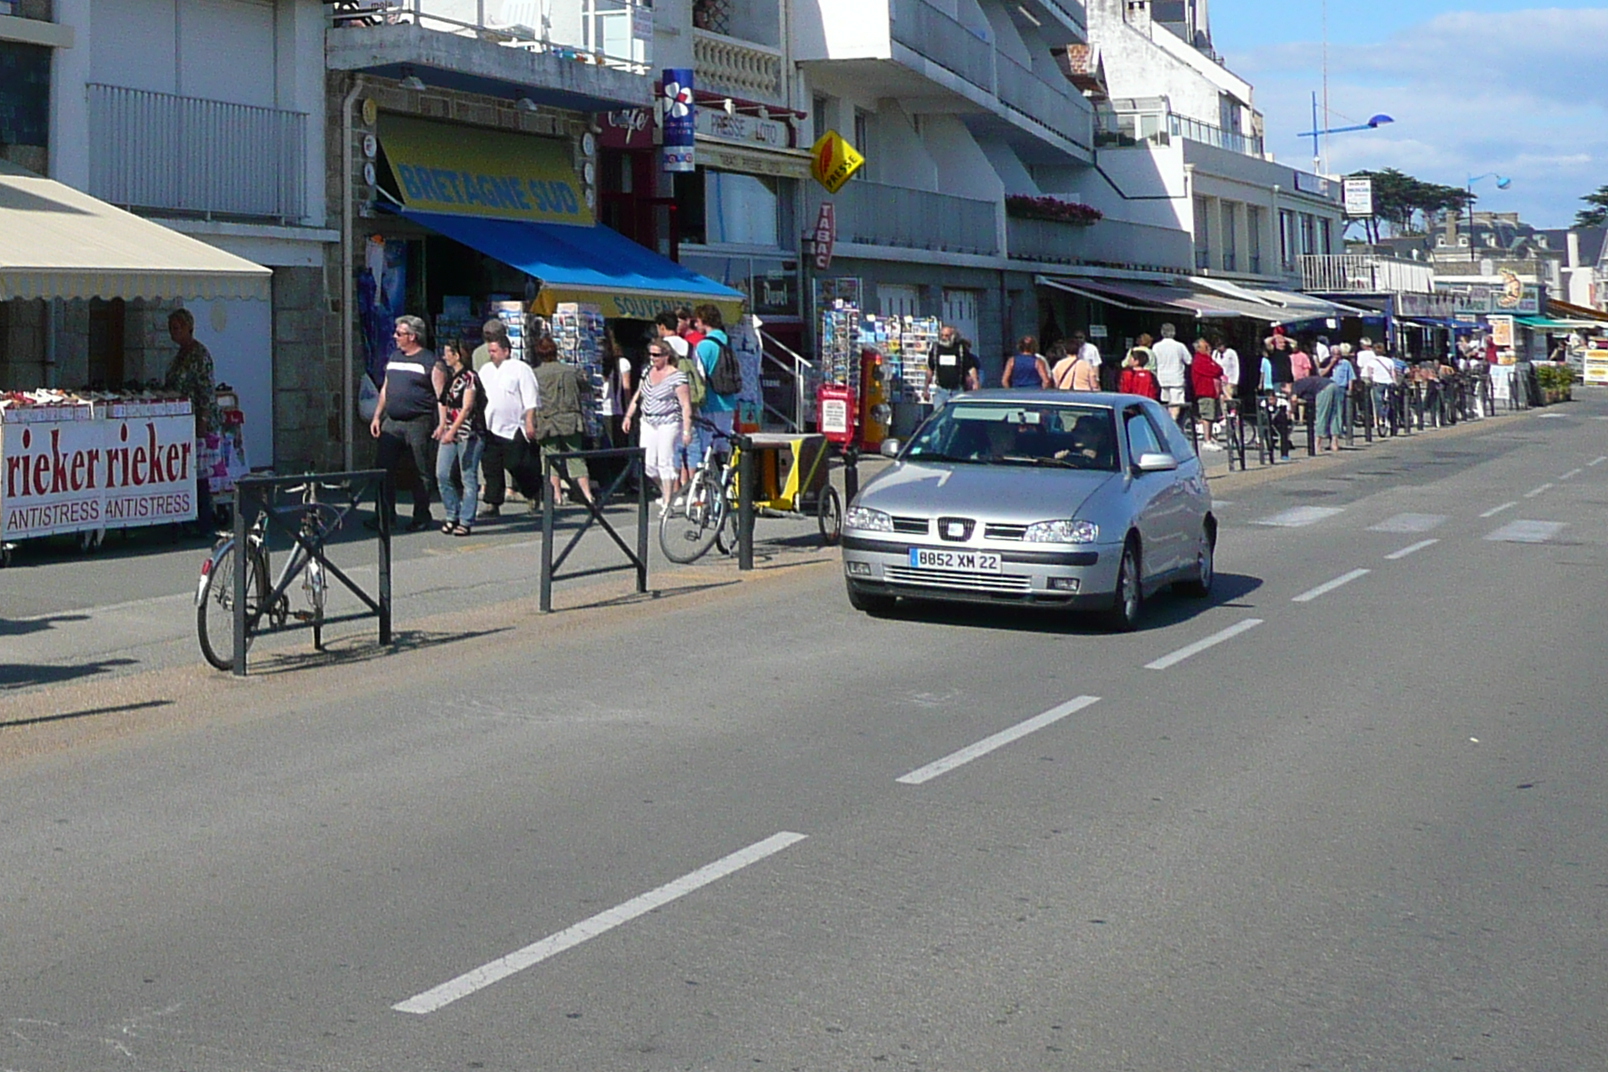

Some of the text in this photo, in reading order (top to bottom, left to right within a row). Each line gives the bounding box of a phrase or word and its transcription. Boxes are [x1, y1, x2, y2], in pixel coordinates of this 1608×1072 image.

[711, 113, 745, 139] PRESSE
[755, 122, 777, 144] LOTO
[397, 163, 579, 214] BRETAGNE SUD
[826, 154, 858, 189] PRESSE
[816, 205, 831, 267] TABAC
[6, 422, 191, 498] rieker rieker
[7, 493, 190, 530] ANTISTRESS ANTISTRESS
[919, 551, 954, 567] 8852
[979, 556, 997, 569] 22
